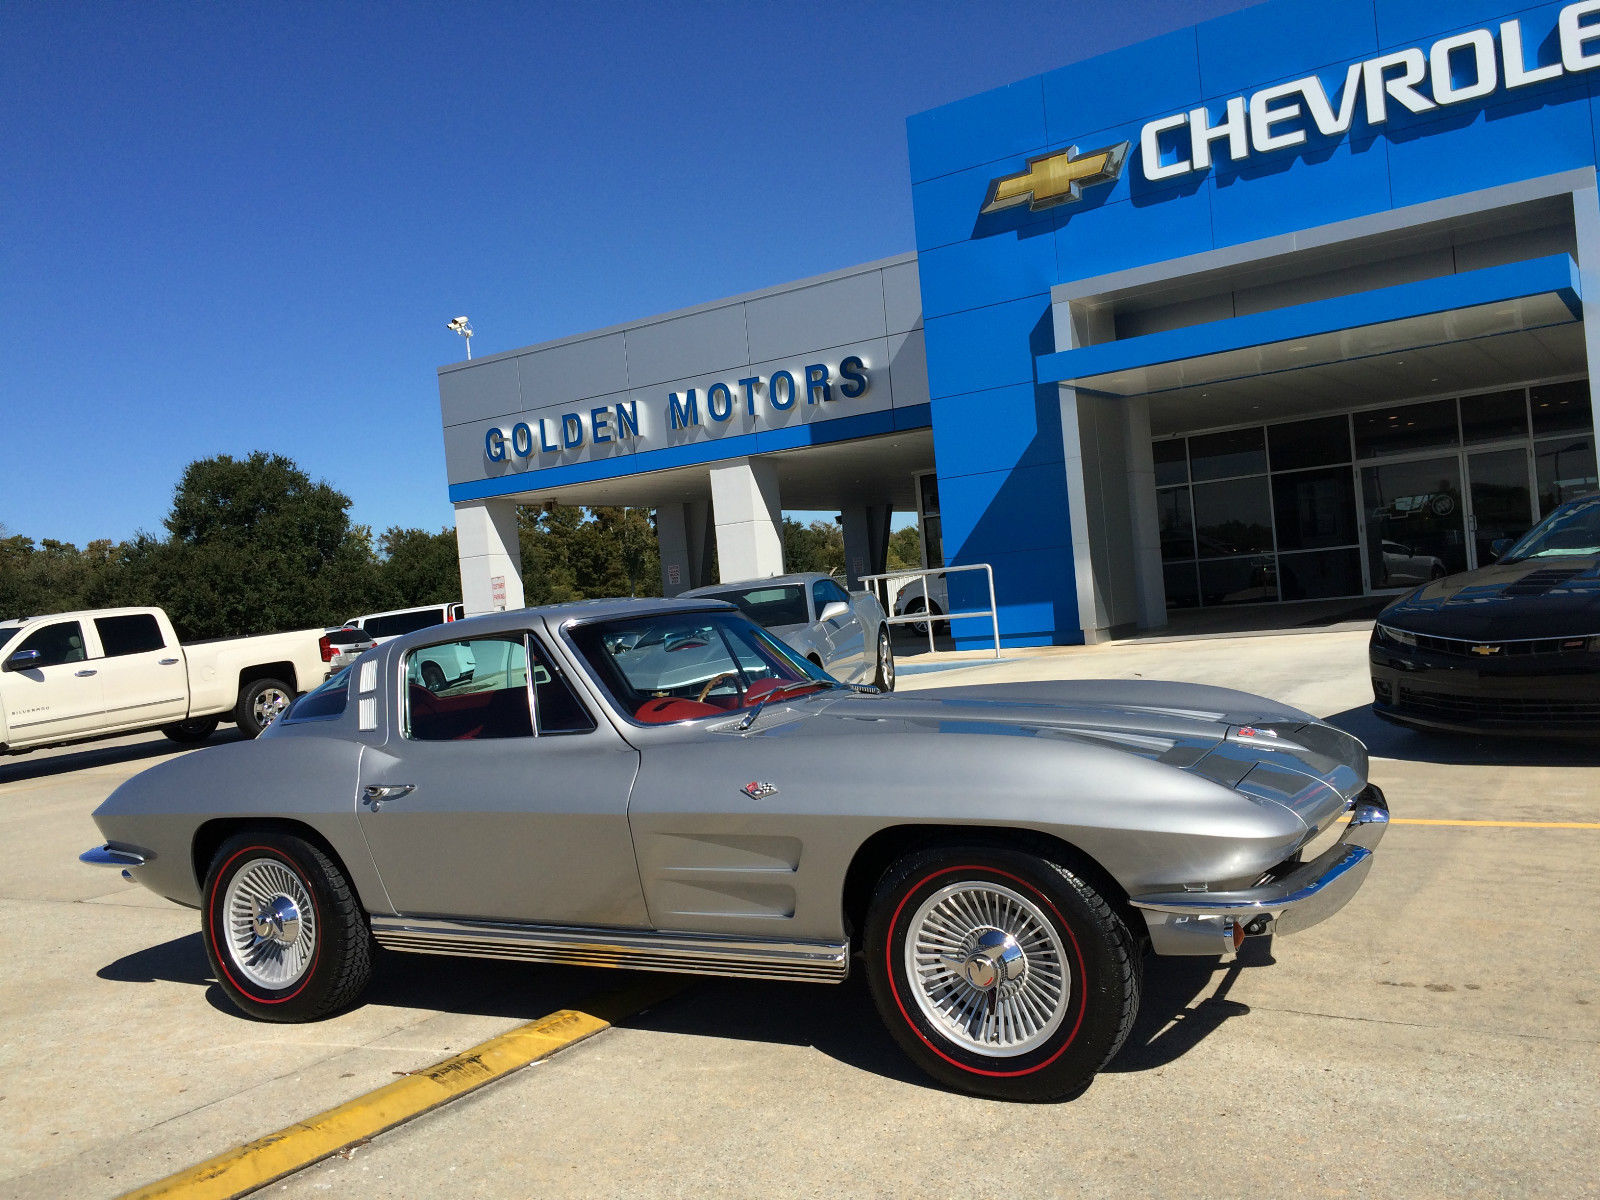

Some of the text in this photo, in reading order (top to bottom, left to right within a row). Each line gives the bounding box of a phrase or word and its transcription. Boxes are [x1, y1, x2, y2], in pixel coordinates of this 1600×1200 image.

[1141, 0, 1600, 180] CHEVROLE
[485, 356, 867, 462] GOLDEN MOTORS
